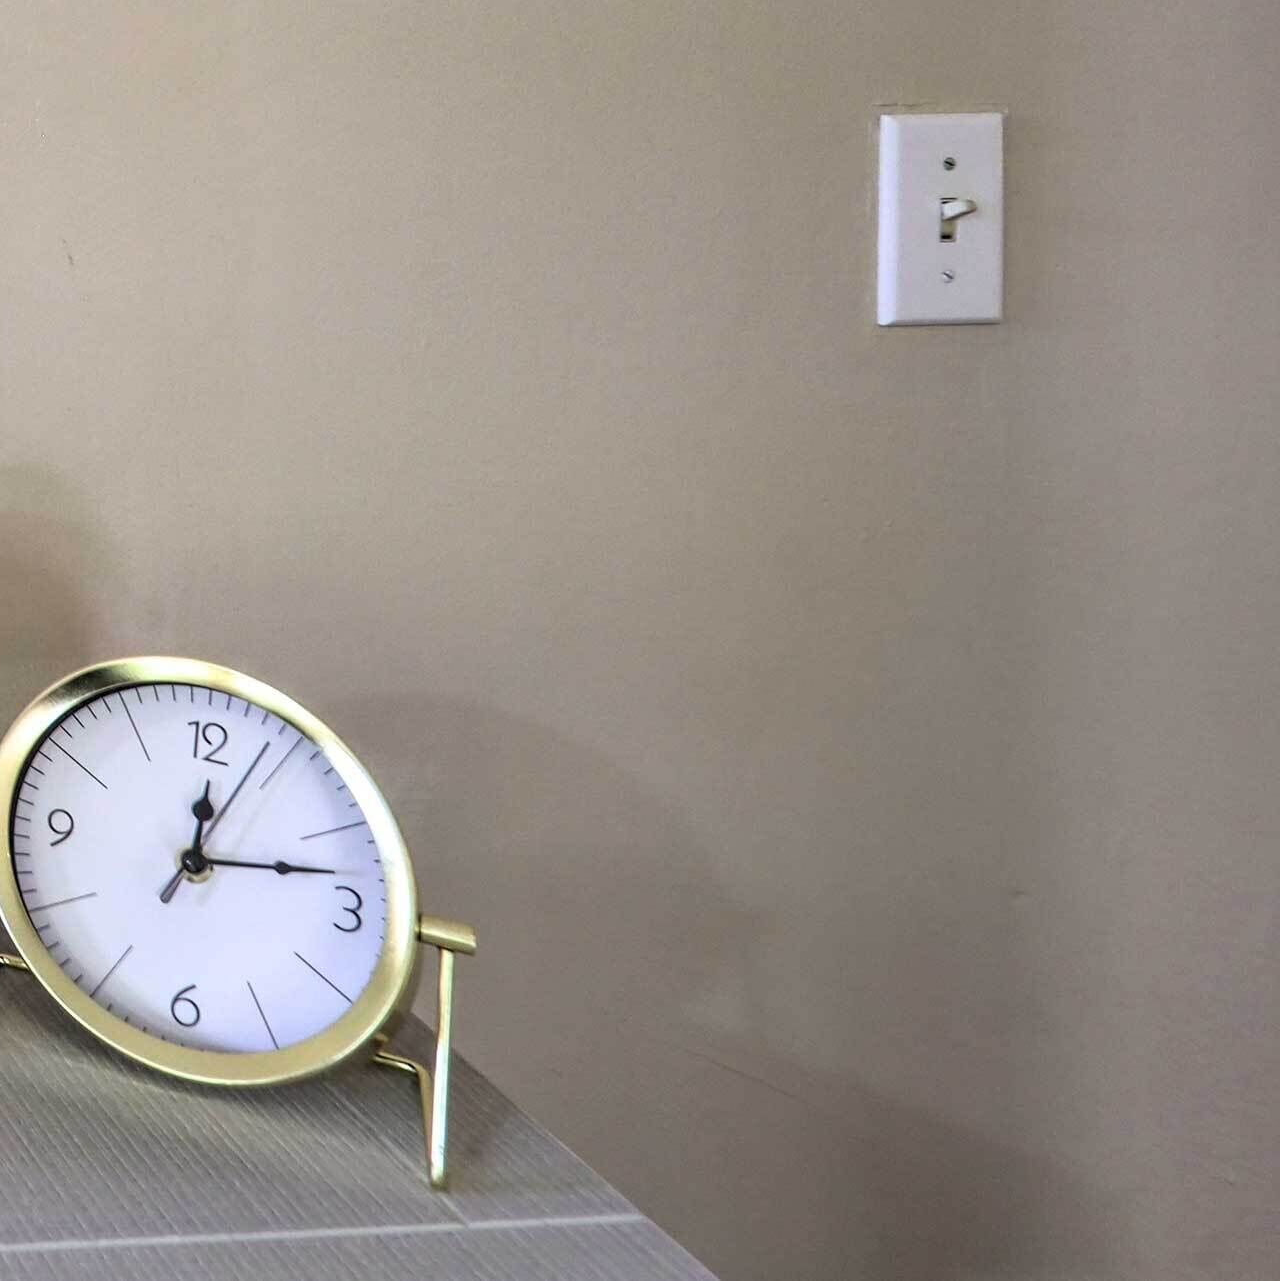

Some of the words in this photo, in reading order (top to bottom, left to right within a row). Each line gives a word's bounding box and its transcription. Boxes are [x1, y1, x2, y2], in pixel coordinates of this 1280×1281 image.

[188, 720, 229, 767] 12
[48, 808, 75, 847] 9
[333, 885, 363, 933] 3
[171, 984, 201, 1027] 6
